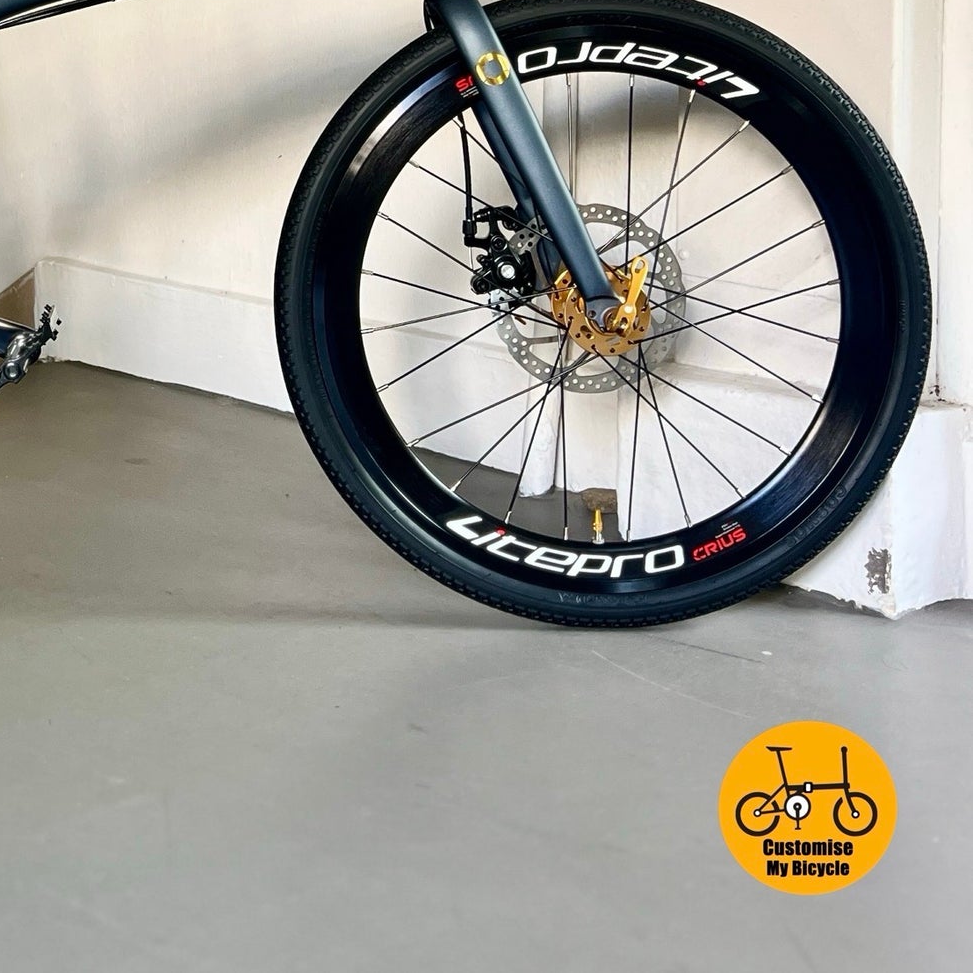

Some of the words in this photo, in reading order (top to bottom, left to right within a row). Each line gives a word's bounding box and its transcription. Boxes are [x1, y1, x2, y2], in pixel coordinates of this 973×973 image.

[517, 42, 761, 100] Litepro
[446, 515, 686, 578] Litepro
[692, 527, 747, 561] CRIUS
